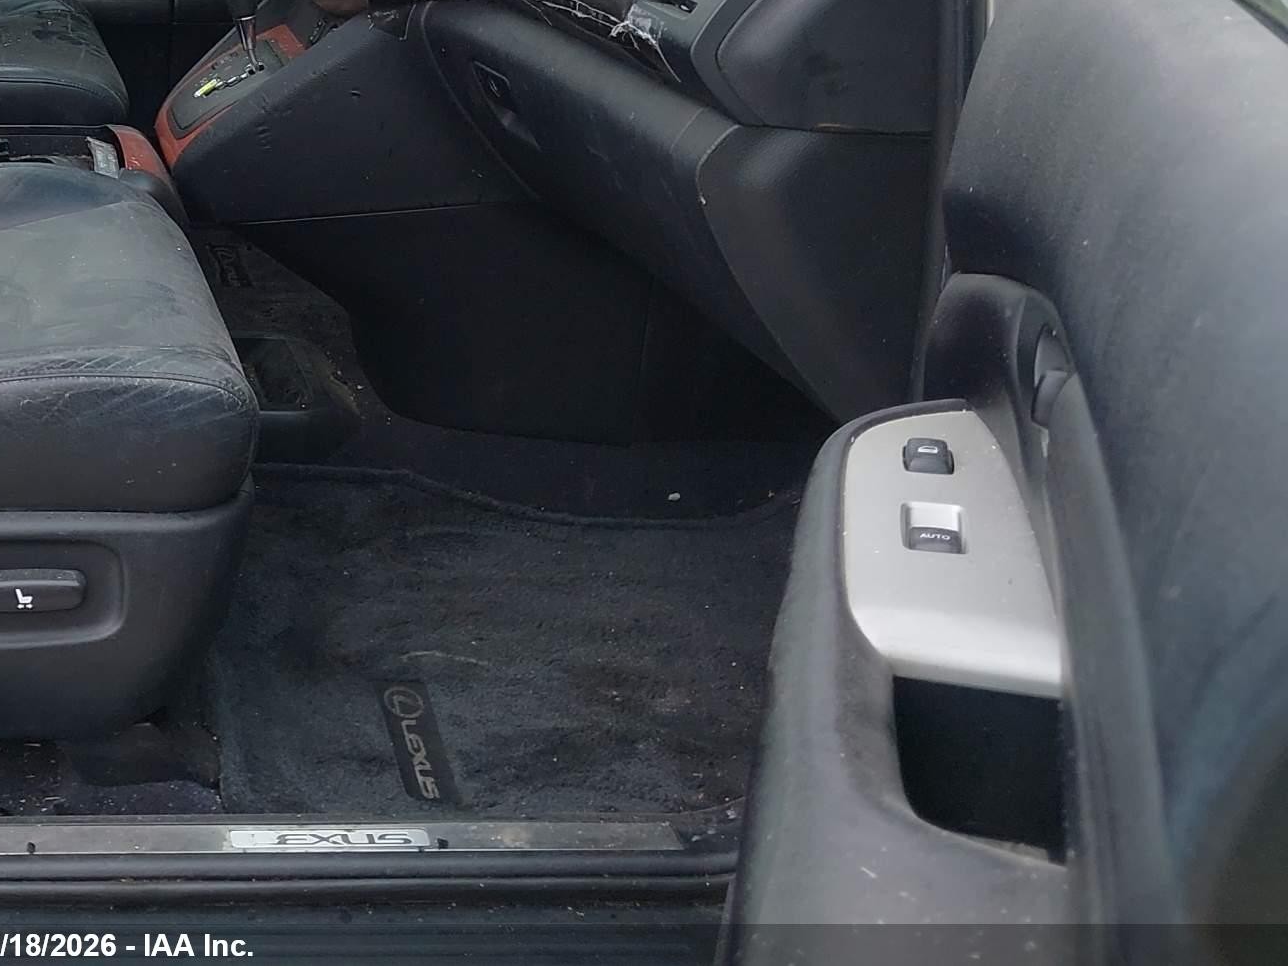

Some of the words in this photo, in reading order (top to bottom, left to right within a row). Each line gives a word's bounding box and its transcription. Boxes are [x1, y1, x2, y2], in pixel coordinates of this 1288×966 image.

[919, 532, 951, 541] AUTO
[400, 719, 441, 800] LEXUS
[257, 832, 413, 846] EXUS
